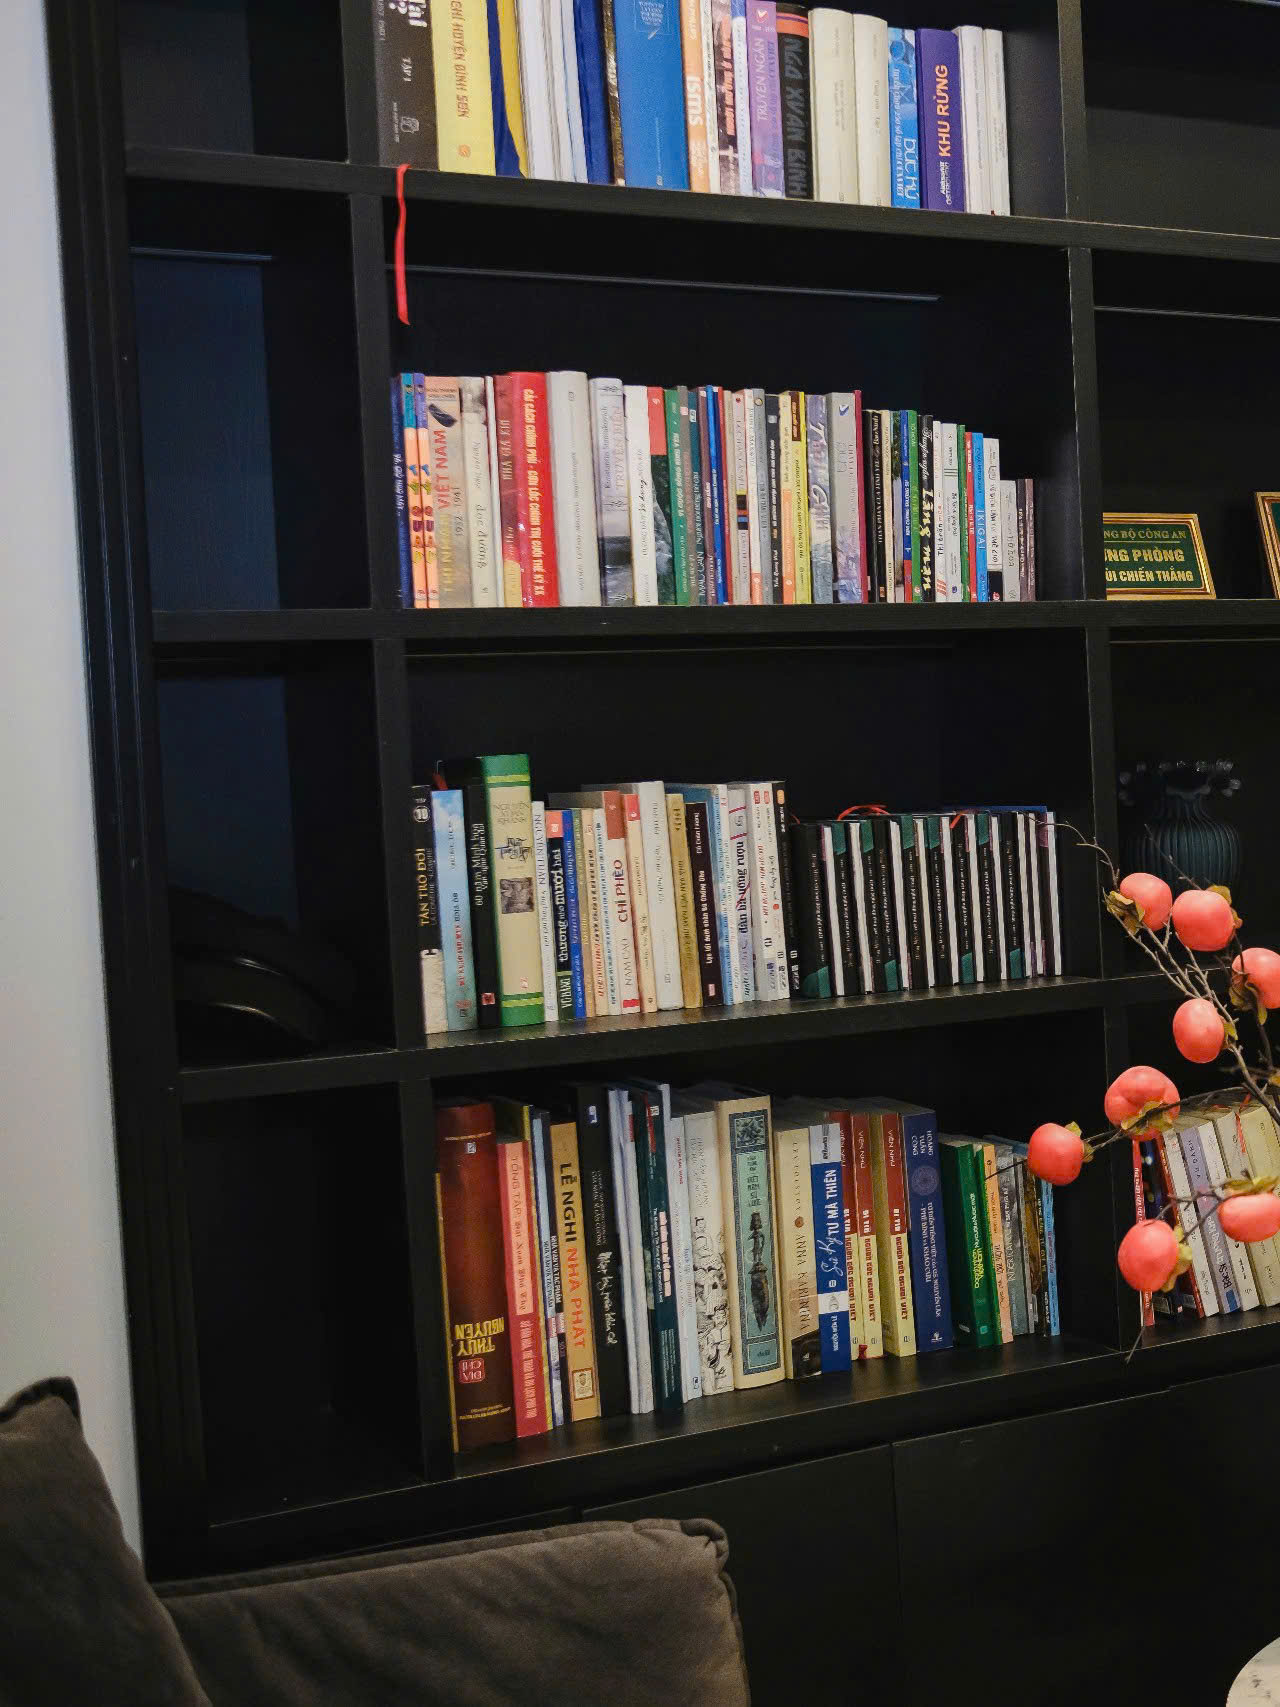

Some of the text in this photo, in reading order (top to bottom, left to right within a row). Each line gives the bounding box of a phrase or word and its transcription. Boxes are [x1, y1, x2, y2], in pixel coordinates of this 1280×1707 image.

[932, 64, 951, 157] KHU RỪNG
[433, 429, 448, 469] NAM
[976, 510, 987, 551] IKIGAI
[1120, 529, 1137, 541] BỘ
[1138, 528, 1170, 540] CÔNG
[1171, 531, 1187, 540] AN
[1118, 566, 1156, 582] CHIẾN
[1156, 565, 1195, 582] THẮNG
[1131, 546, 1185, 562] PHÒNG
[551, 847, 562, 867] hai
[612, 859, 629, 923] CHÍ PHÈO
[824, 1169, 838, 1200] THIÊN
[559, 1163, 587, 1350] LỄ NGHI NHÀ PHẬT
[796, 1233, 812, 1331] ANNA KARENINA
